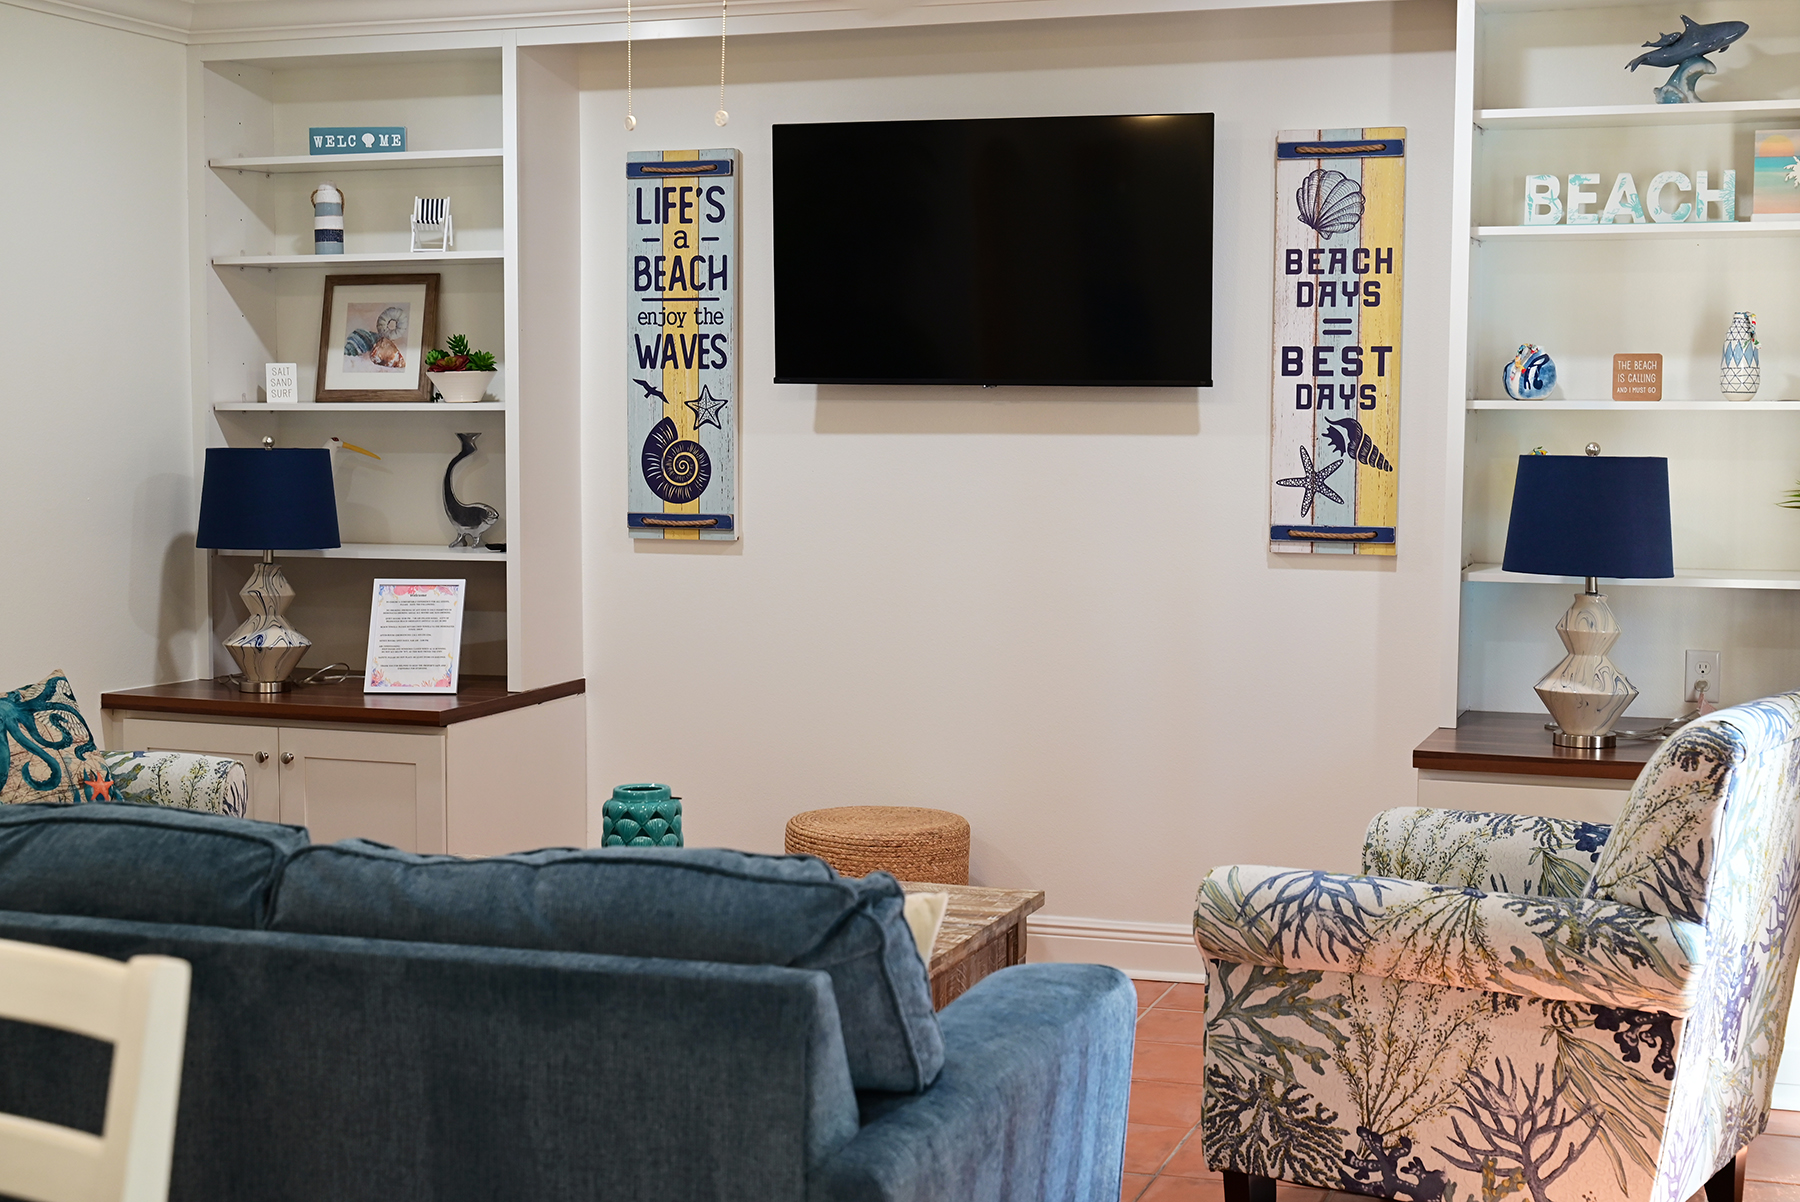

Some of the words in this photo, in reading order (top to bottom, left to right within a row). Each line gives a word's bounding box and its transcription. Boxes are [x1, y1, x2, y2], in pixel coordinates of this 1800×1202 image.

[313, 133, 402, 148] WELCME
[636, 186, 726, 225] LIFE'S
[1523, 169, 1736, 225] BEACH
[673, 229, 690, 249] a
[1285, 247, 1393, 275] BEACH
[634, 255, 728, 292] BEACH
[1296, 280, 1381, 308] DAYS
[637, 307, 688, 328] enjoy
[693, 307, 724, 326] the
[634, 333, 728, 370] WAVES
[1281, 345, 1393, 377] BEST
[271, 367, 290, 376] SALT
[1617, 360, 1631, 370] THE
[1634, 360, 1657, 370] BEACH
[270, 377, 293, 387] SAND
[1617, 373, 1625, 383] IS
[1627, 373, 1656, 383] CALLING
[271, 389, 292, 398] SURF
[1295, 383, 1377, 411] DAYS
[1616, 386, 1628, 394] AND
[1632, 386, 1646, 394] MUST
[1647, 386, 1657, 394] GO
